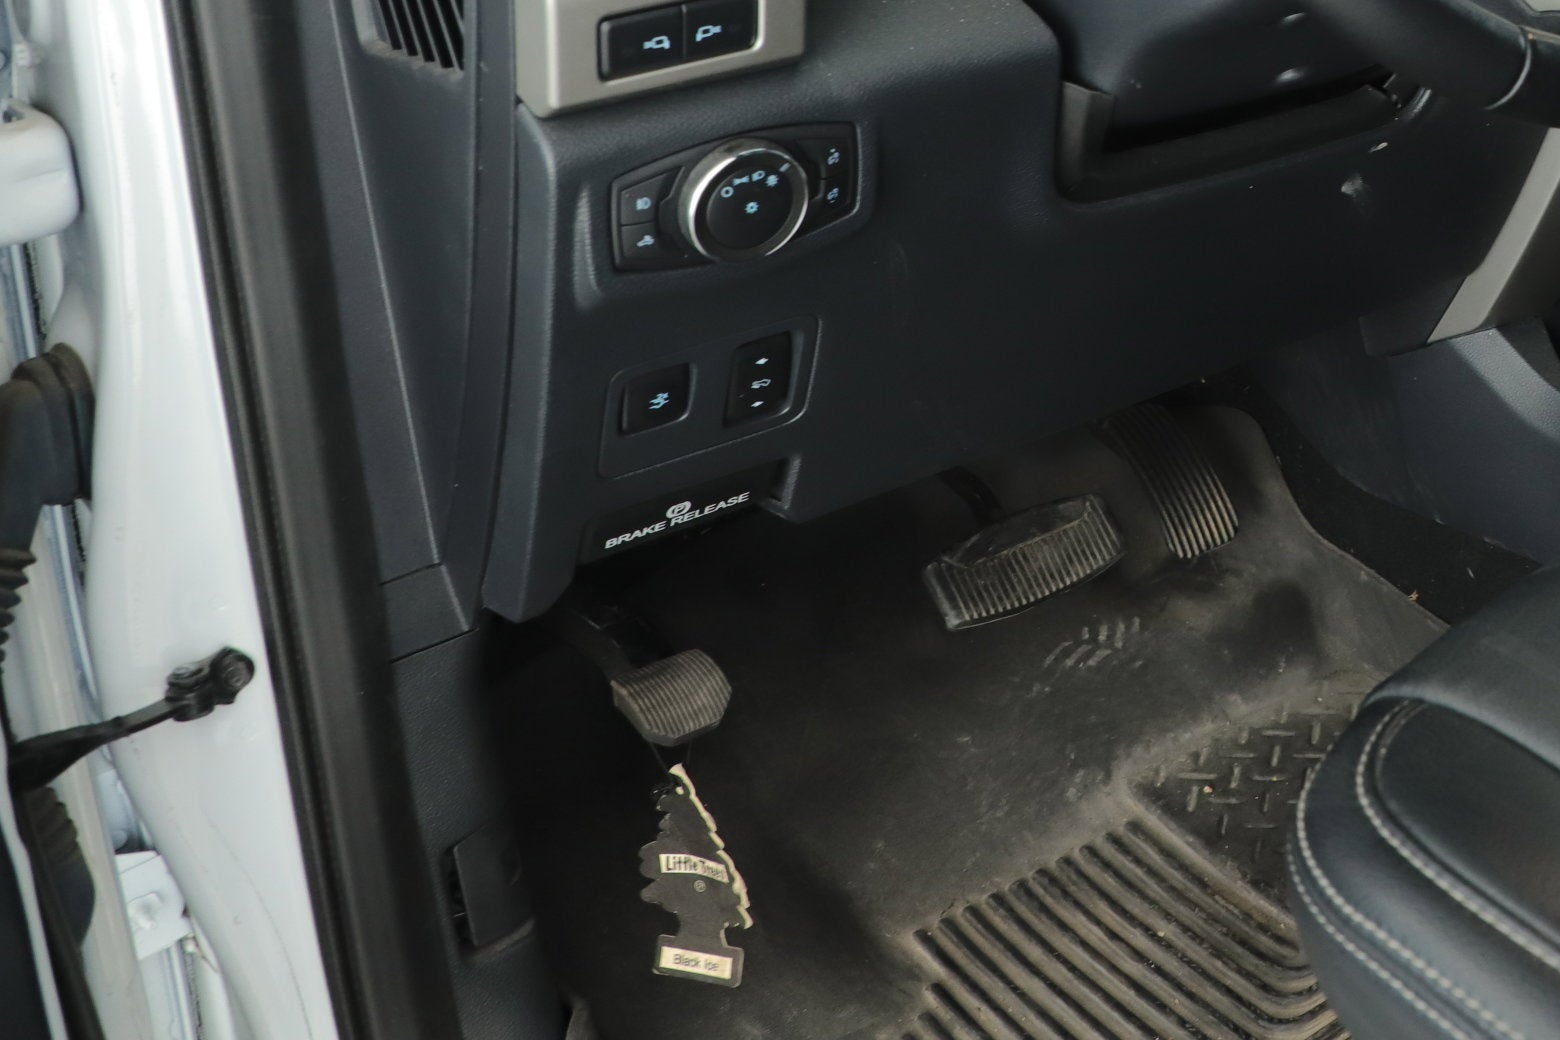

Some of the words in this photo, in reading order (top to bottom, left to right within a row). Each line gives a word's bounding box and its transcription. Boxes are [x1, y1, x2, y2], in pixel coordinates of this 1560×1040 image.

[604, 520, 667, 549] BRAKE
[669, 491, 751, 527] RELEASE
[666, 855, 698, 872] Little
[673, 953, 701, 969] Black
